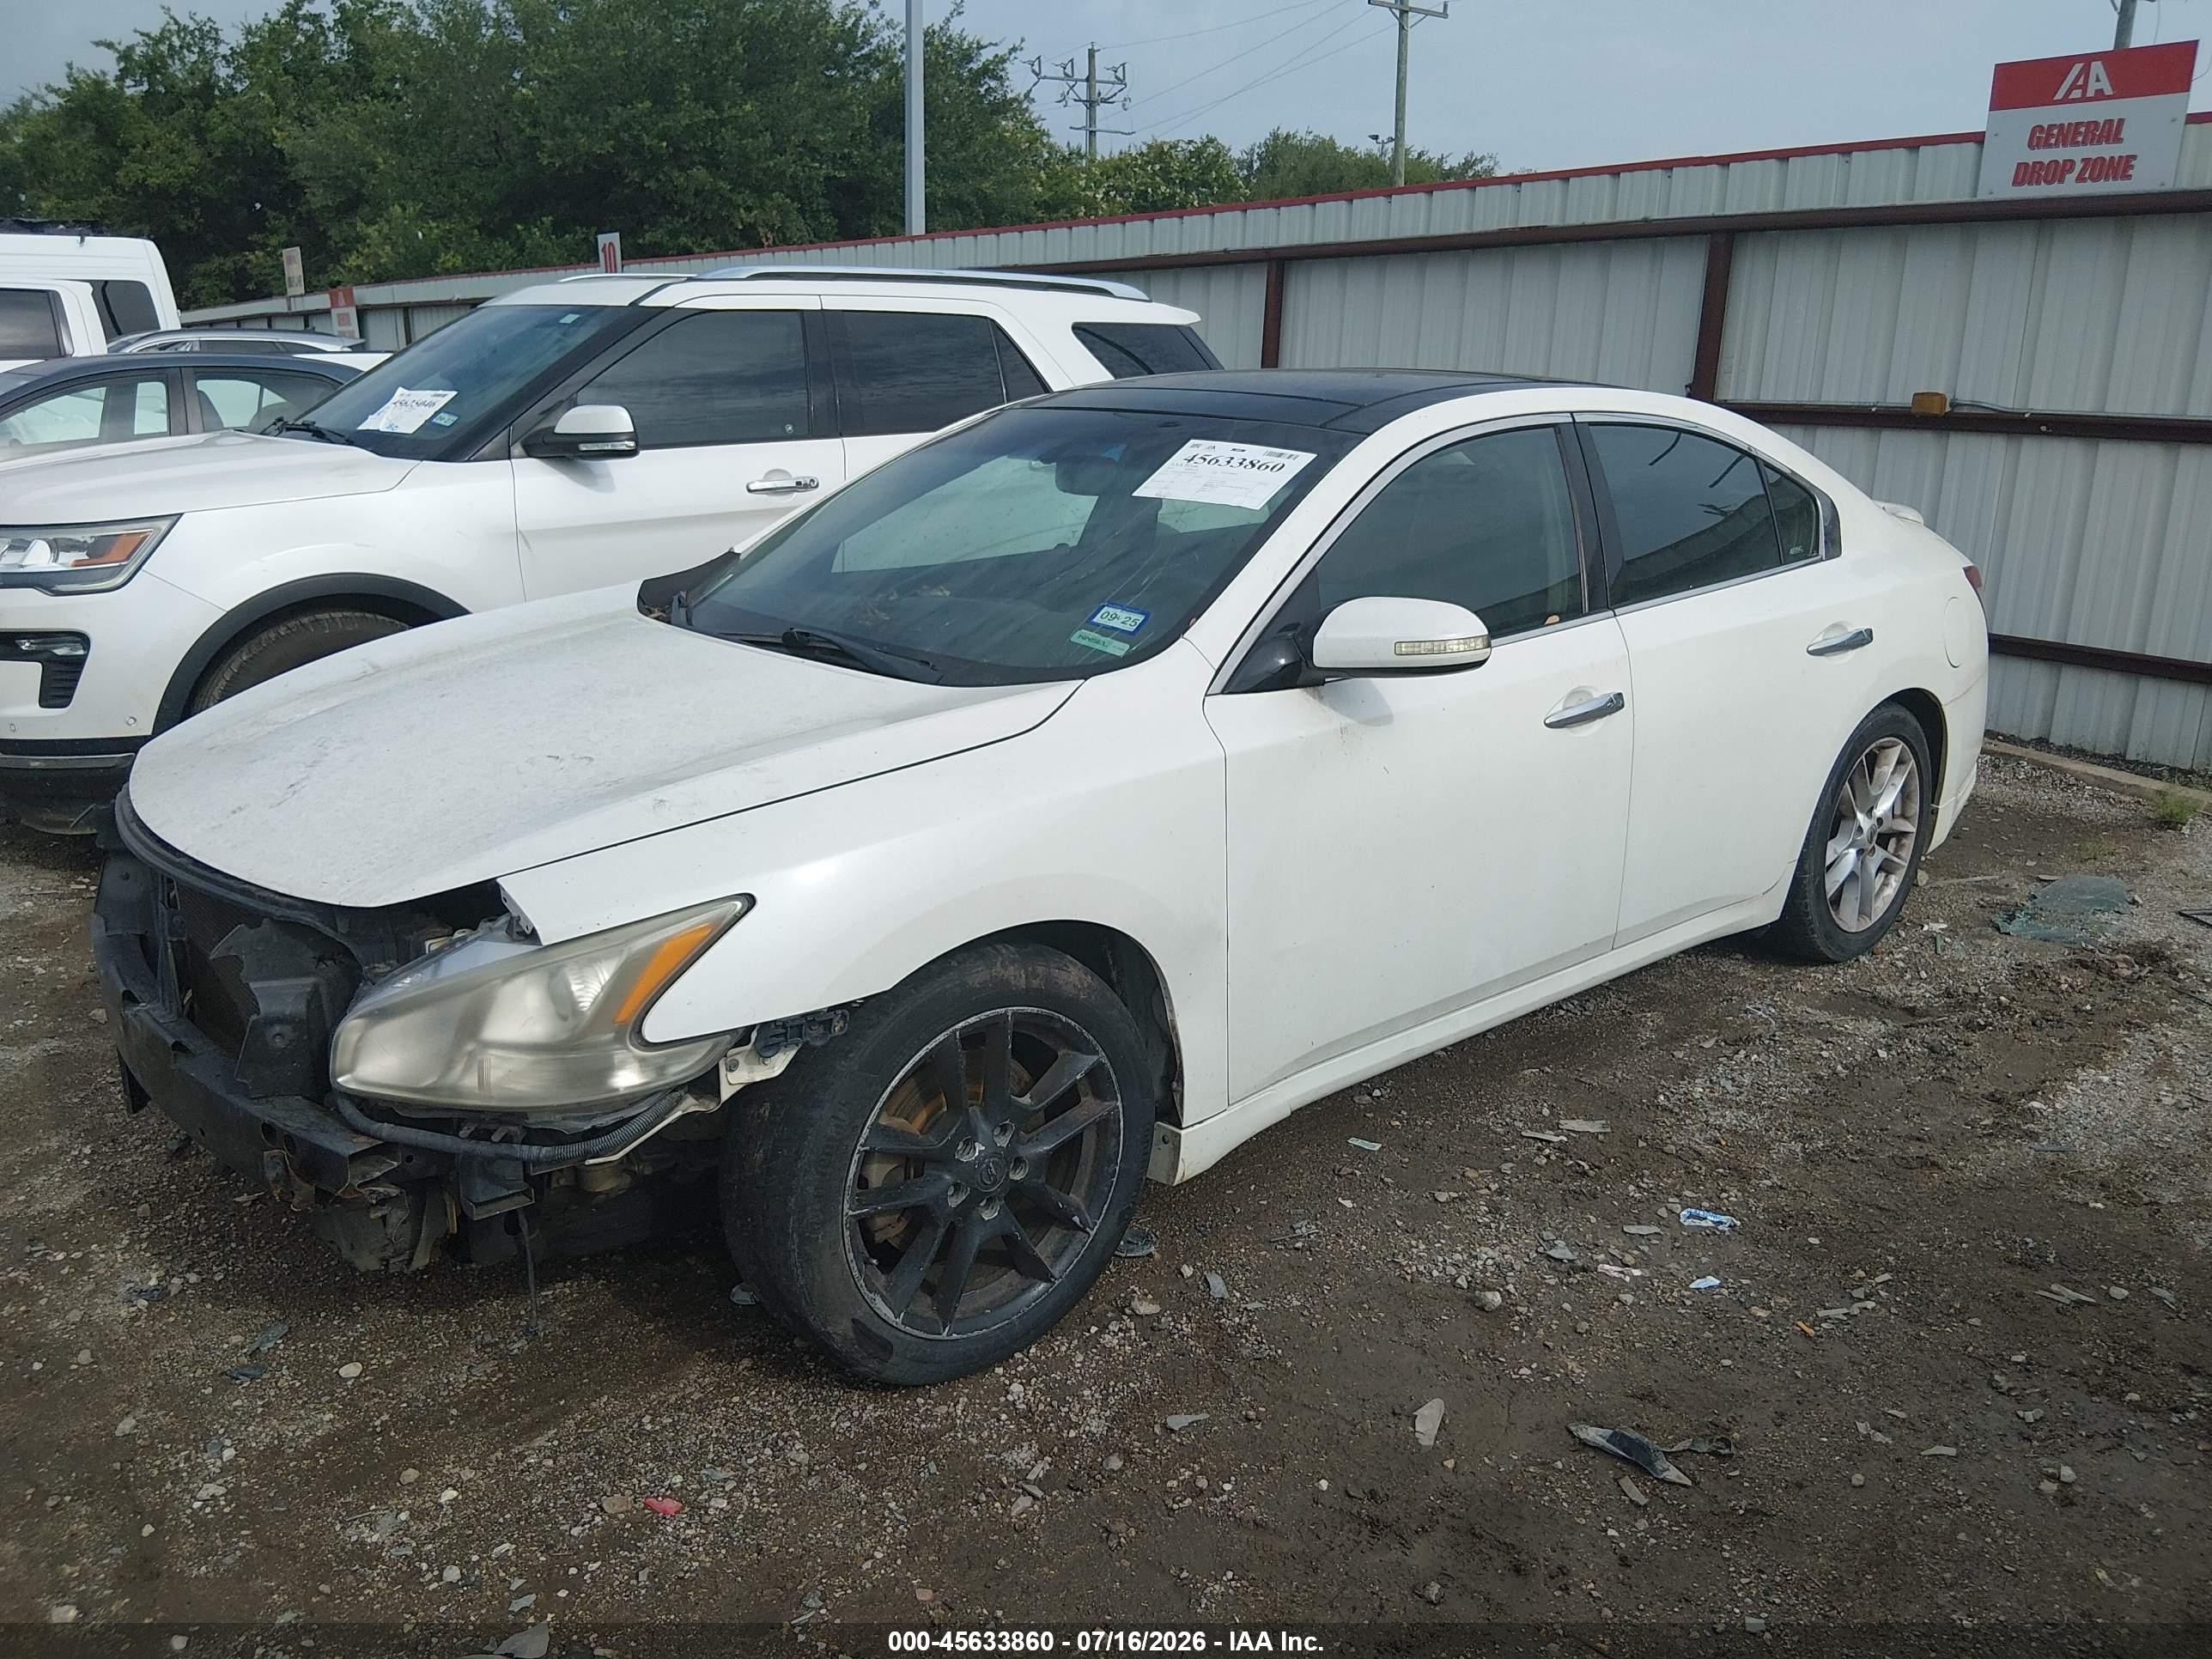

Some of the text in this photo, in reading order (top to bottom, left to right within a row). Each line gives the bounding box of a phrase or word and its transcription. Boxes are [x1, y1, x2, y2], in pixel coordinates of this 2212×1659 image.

[2027, 118, 2126, 150] GENERAL
[2012, 155, 2137, 186] DROP ZONE
[1183, 453, 1285, 472] 45633860
